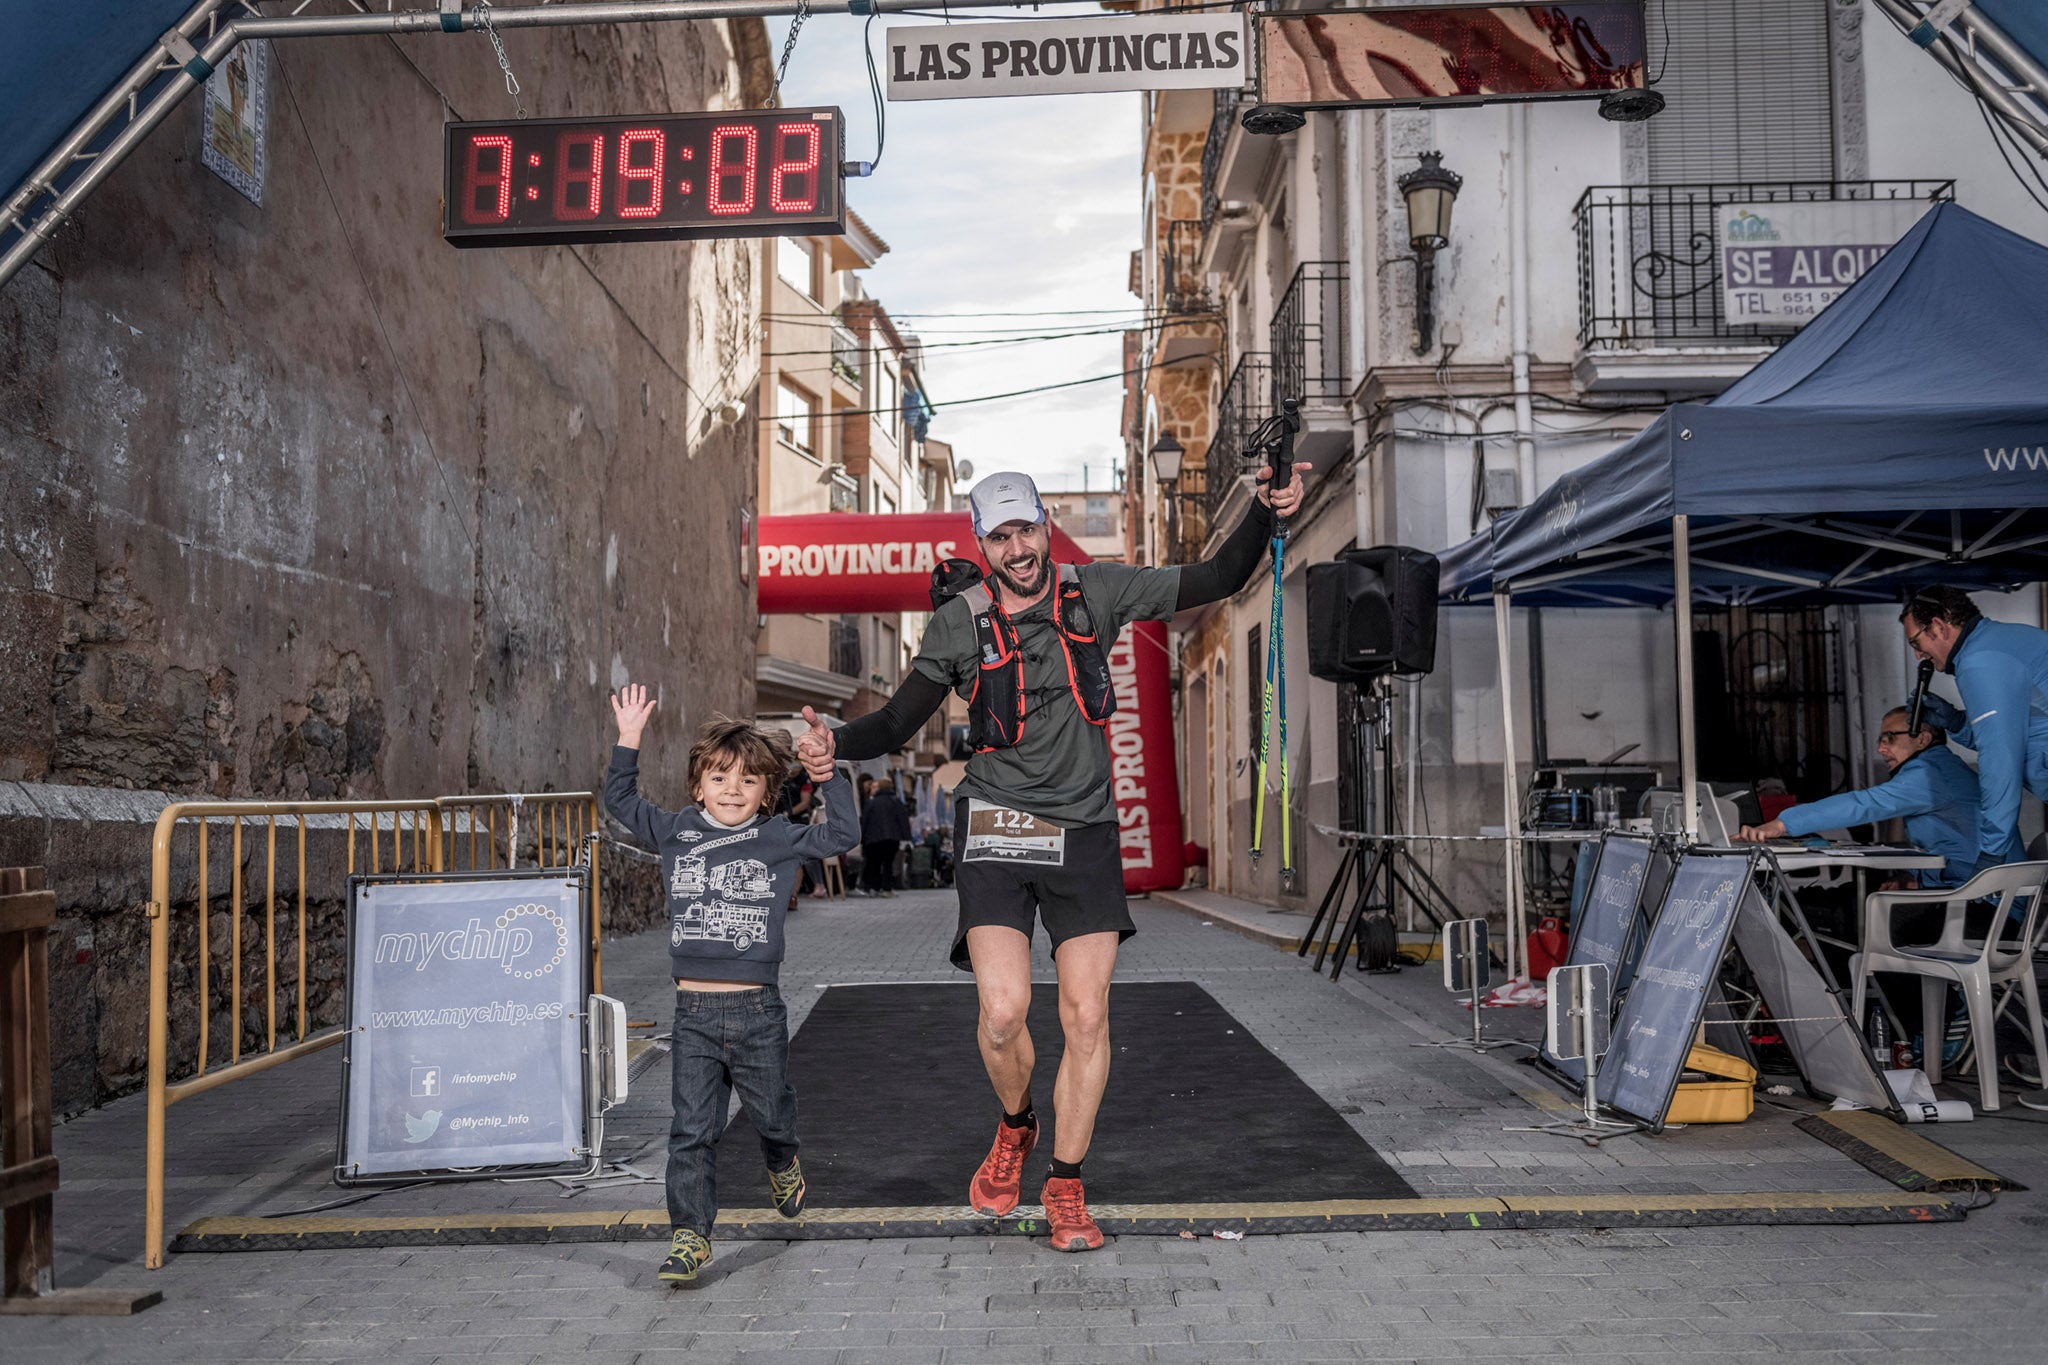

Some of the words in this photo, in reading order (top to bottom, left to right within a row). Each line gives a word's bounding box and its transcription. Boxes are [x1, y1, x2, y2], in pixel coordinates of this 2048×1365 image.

[892, 42, 971, 83] LAS
[981, 31, 1239, 79] PROVINCIAS
[471, 123, 822, 219] 7:19:02
[1732, 250, 1774, 285] SE
[1782, 291, 1813, 303] 651
[1783, 305, 1816, 316] 964
[758, 541, 957, 577] PROVINCIAS
[993, 810, 1035, 829] 122
[1116, 803, 1154, 870] LAS
[374, 916, 533, 972] mychip
[371, 1000, 563, 1029] www.mychip.es
[451, 1071, 517, 1085] /infomychip
[450, 1114, 529, 1130] @Mychip_Info
